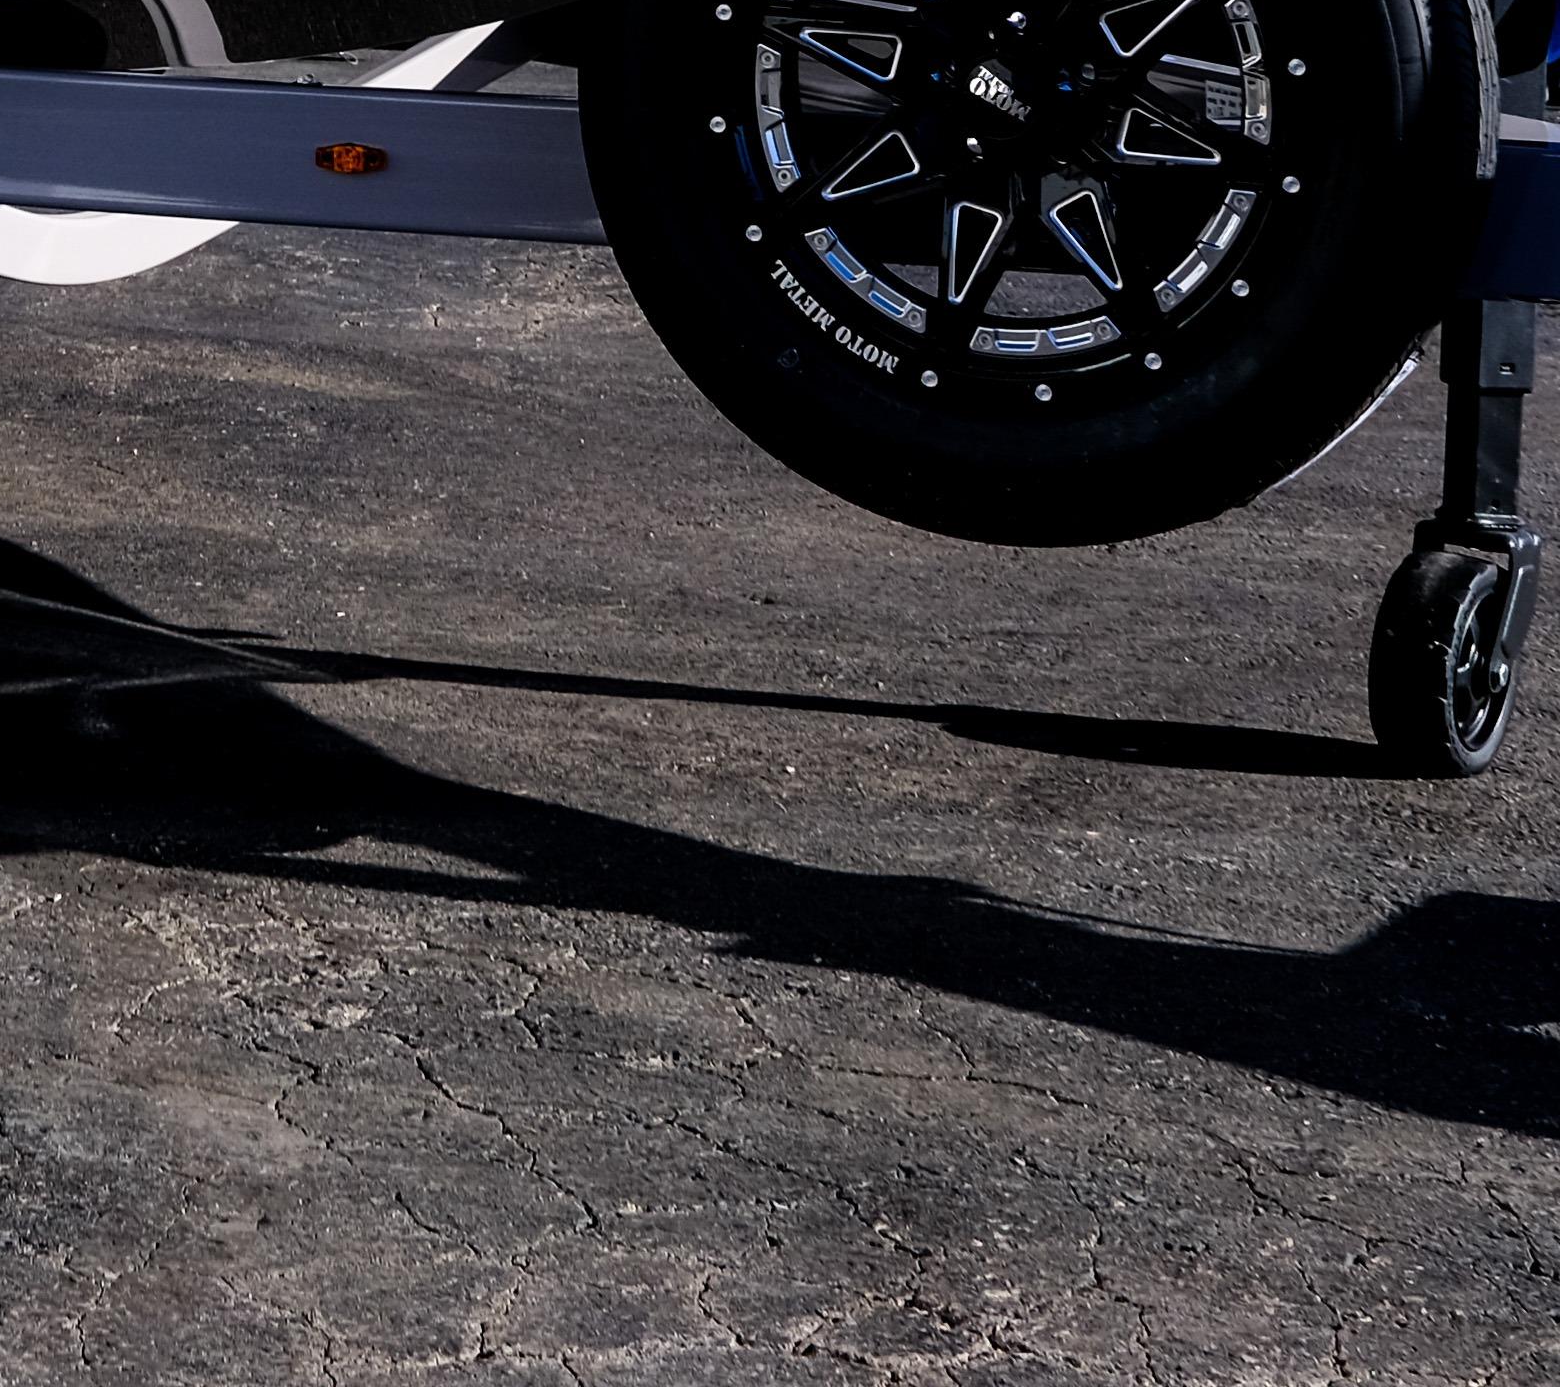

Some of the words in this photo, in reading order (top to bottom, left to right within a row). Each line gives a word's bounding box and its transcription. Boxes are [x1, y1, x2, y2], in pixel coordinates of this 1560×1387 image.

[969, 77, 1032, 122] MOTO
[770, 258, 836, 332] METAL
[834, 325, 900, 375] MOTO
